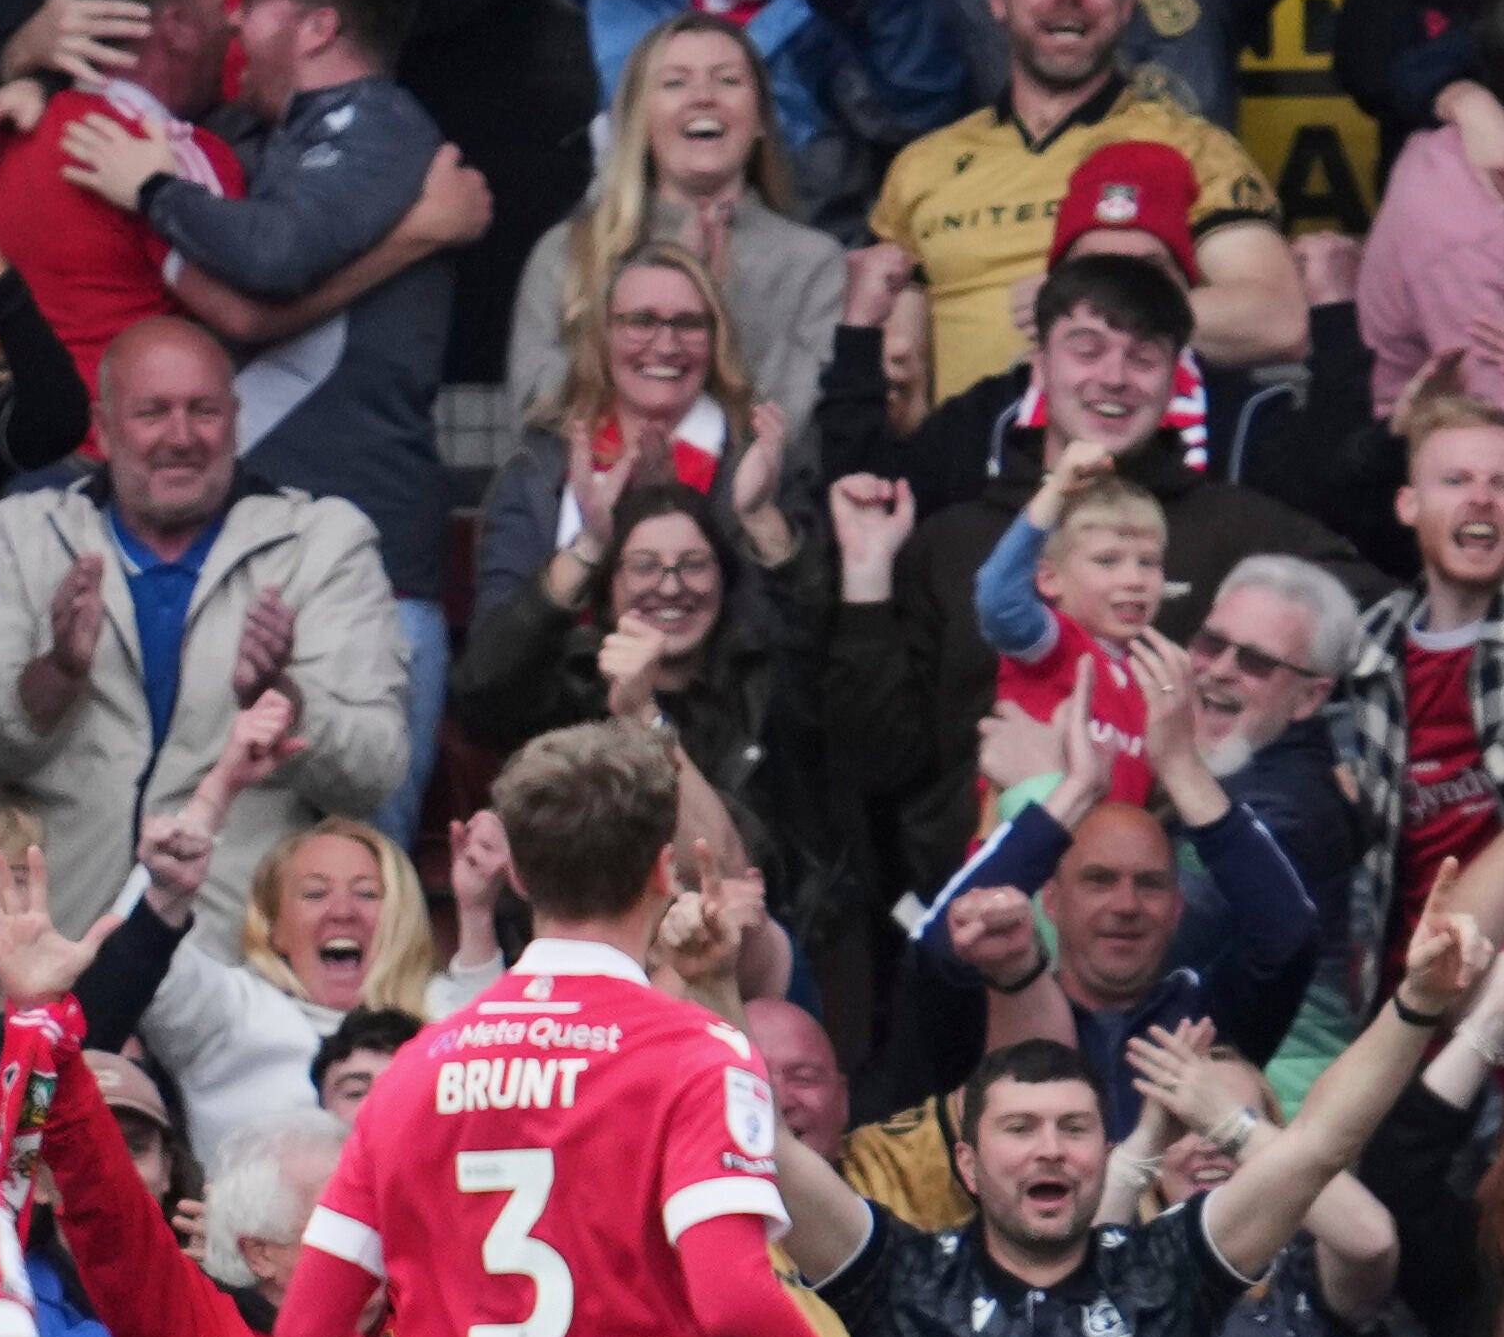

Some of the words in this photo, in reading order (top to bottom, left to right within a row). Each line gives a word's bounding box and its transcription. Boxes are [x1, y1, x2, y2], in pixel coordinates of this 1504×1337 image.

[455, 1019, 525, 1050] Meta
[528, 1019, 624, 1053] Quest
[436, 1058, 589, 1114] BRUNT
